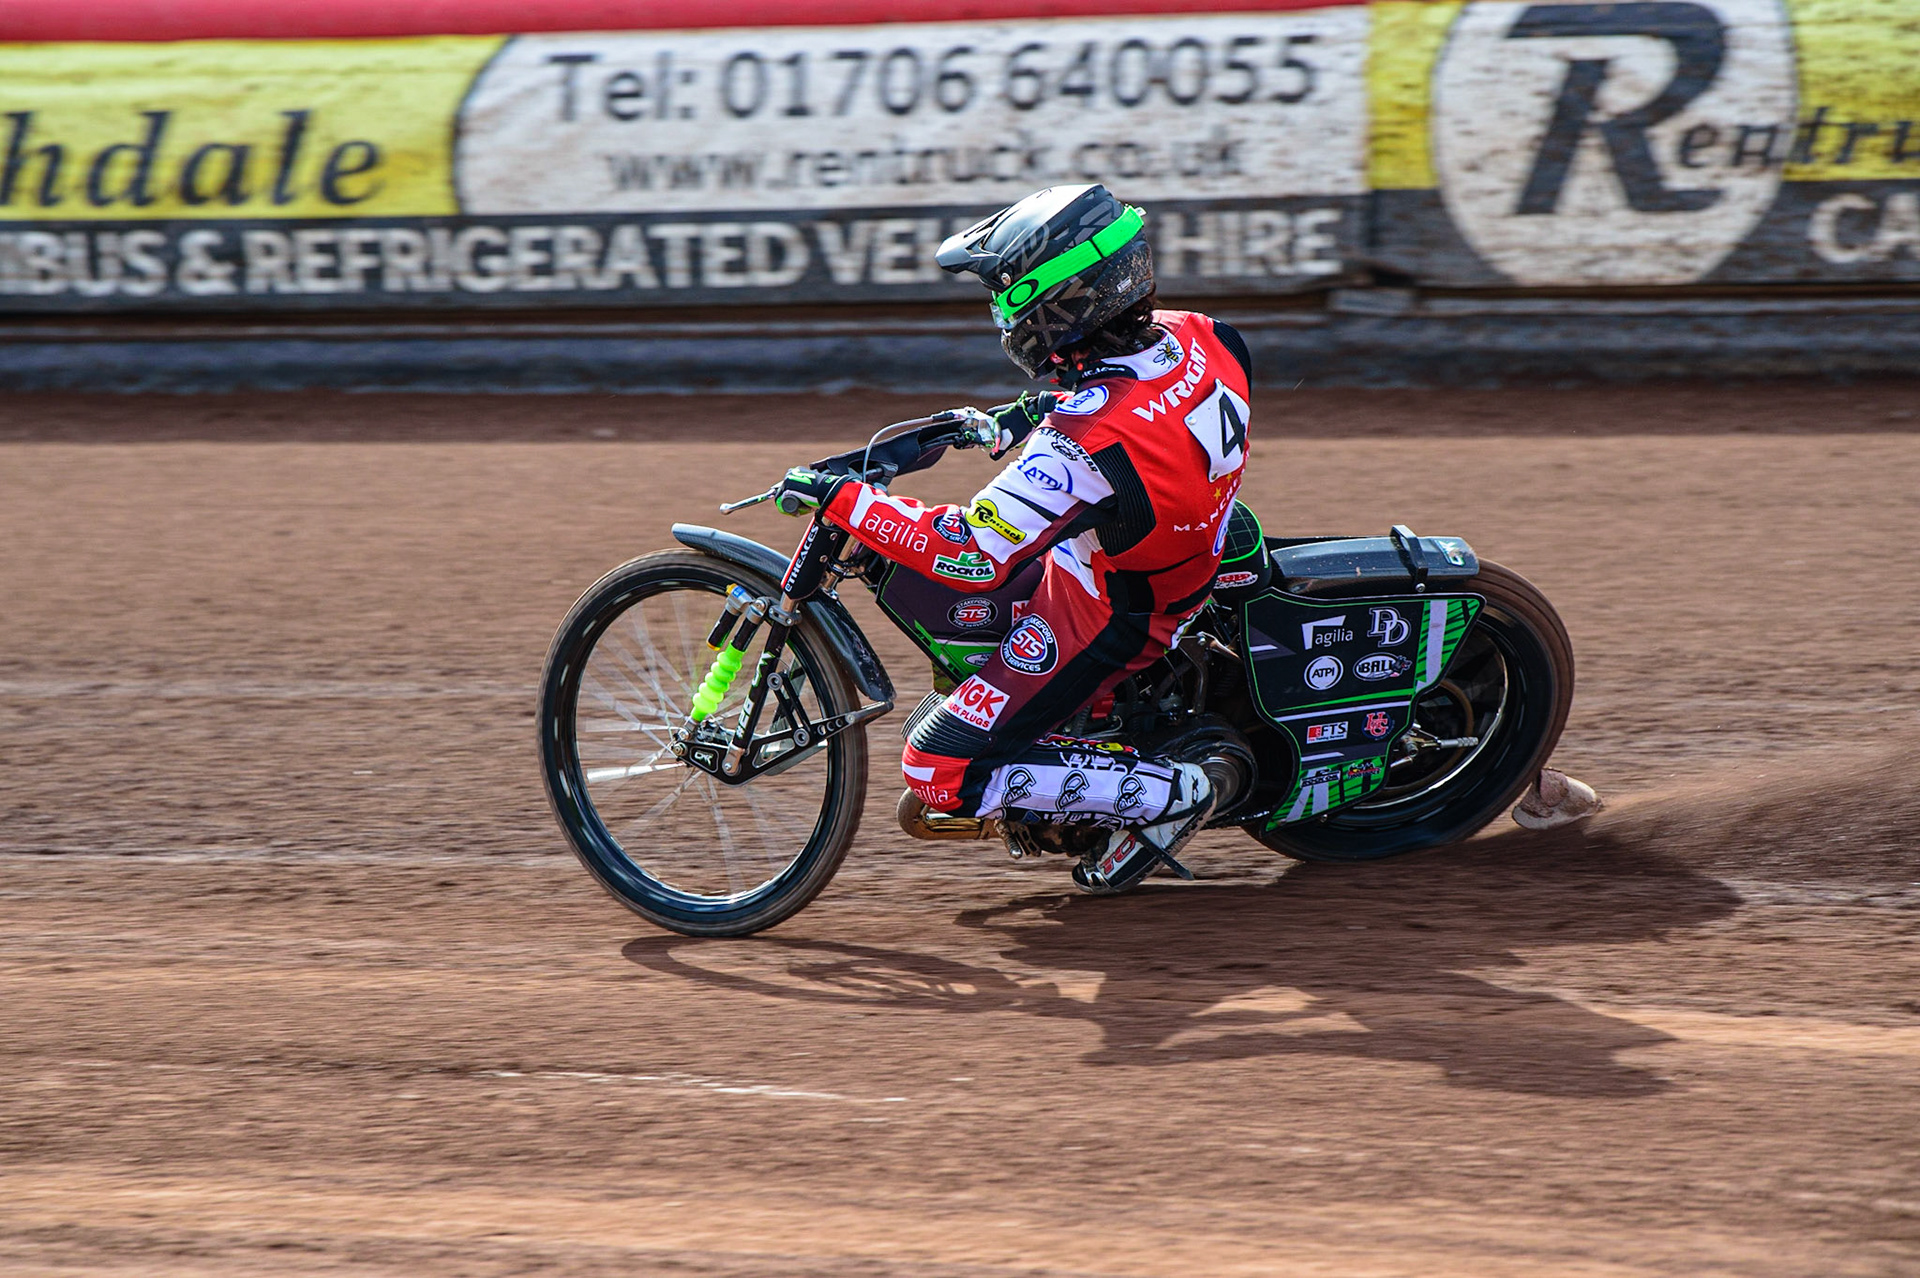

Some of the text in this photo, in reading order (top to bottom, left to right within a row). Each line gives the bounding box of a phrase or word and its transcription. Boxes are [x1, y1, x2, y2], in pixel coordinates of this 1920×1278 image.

[547, 35, 1319, 122] Tel: 01706 640055
[177, 229, 240, 296] &
[243, 222, 810, 295] REFRIGERATED
[1157, 208, 1344, 278] HIRE
[1218, 391, 1247, 459] 4
[864, 512, 929, 553] agilia
[957, 608, 988, 619] STS
[1011, 629, 1045, 657] STS
[1314, 628, 1354, 648] agilia
[1311, 666, 1336, 679] ATPI
[952, 678, 1004, 719] NGK
[960, 709, 991, 728] PLUGS
[1321, 722, 1347, 737] FTS
